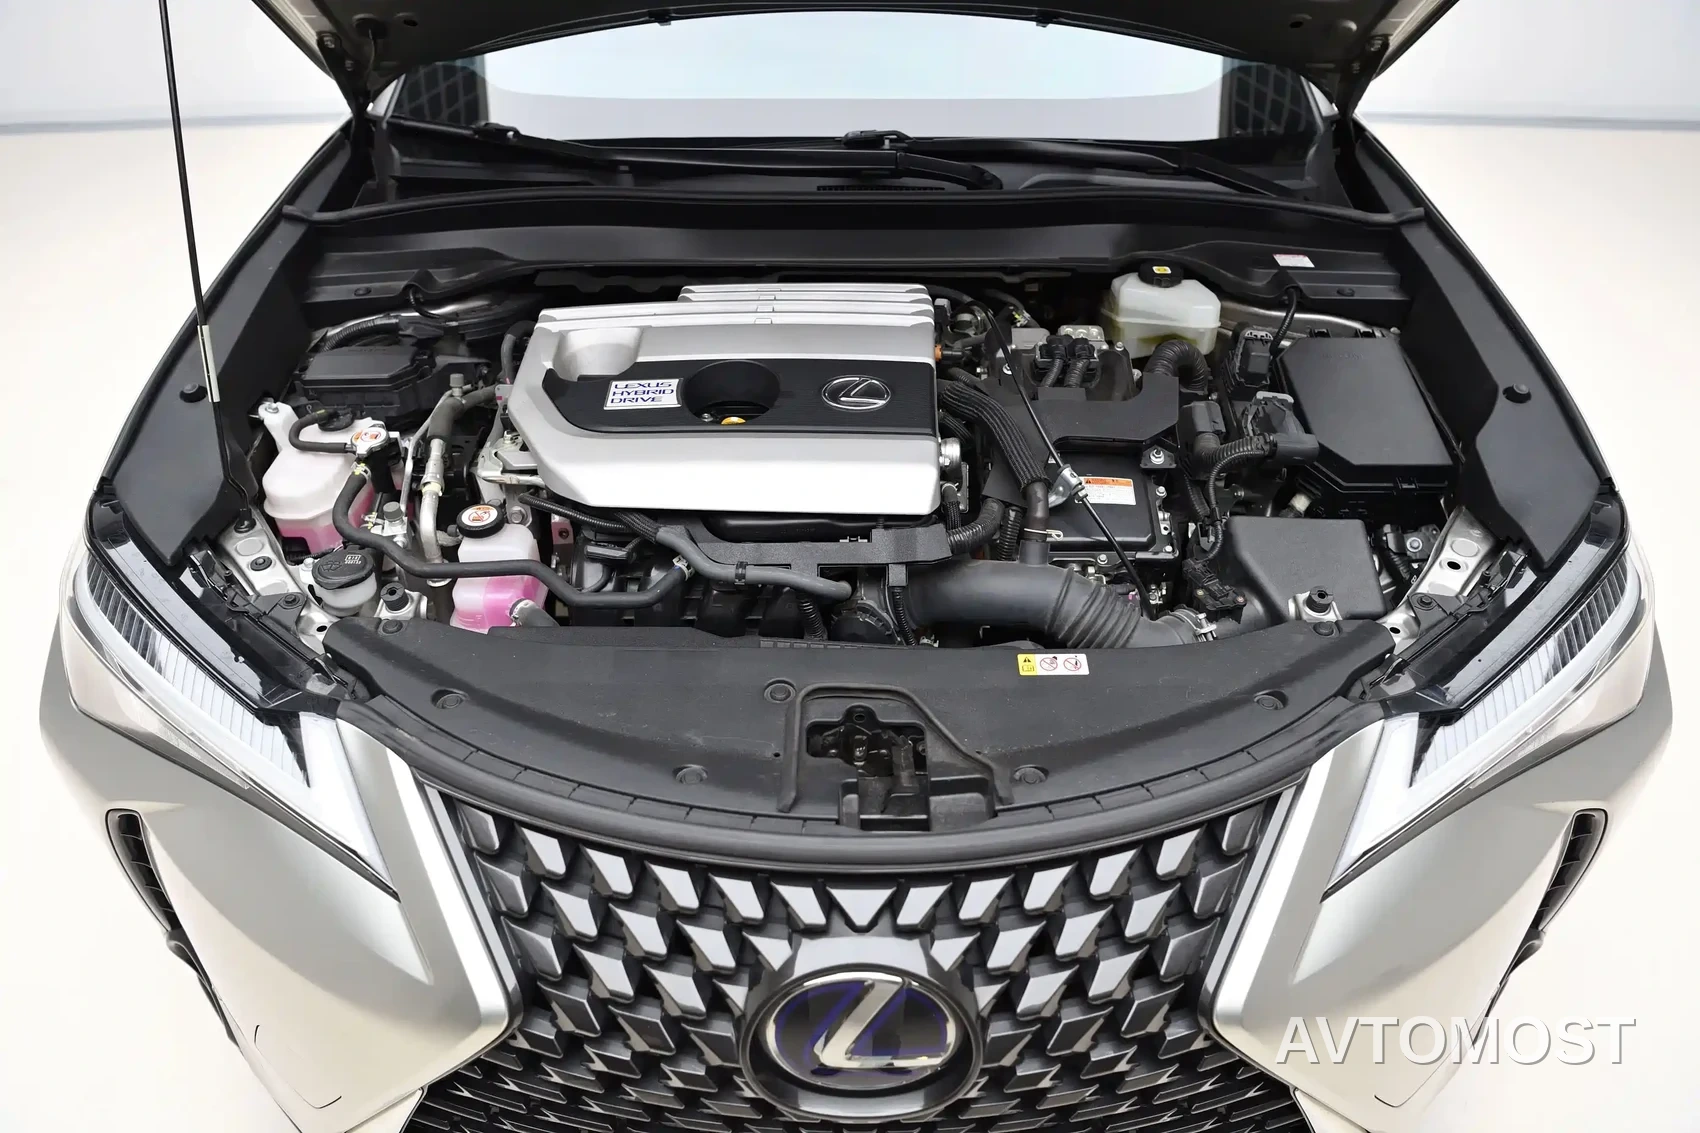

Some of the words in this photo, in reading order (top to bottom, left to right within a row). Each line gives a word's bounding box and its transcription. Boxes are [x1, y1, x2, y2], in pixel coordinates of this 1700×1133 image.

[614, 381, 672, 390] LEXUS
[612, 388, 675, 397] HYBRID
[610, 395, 663, 404] DRIVE
